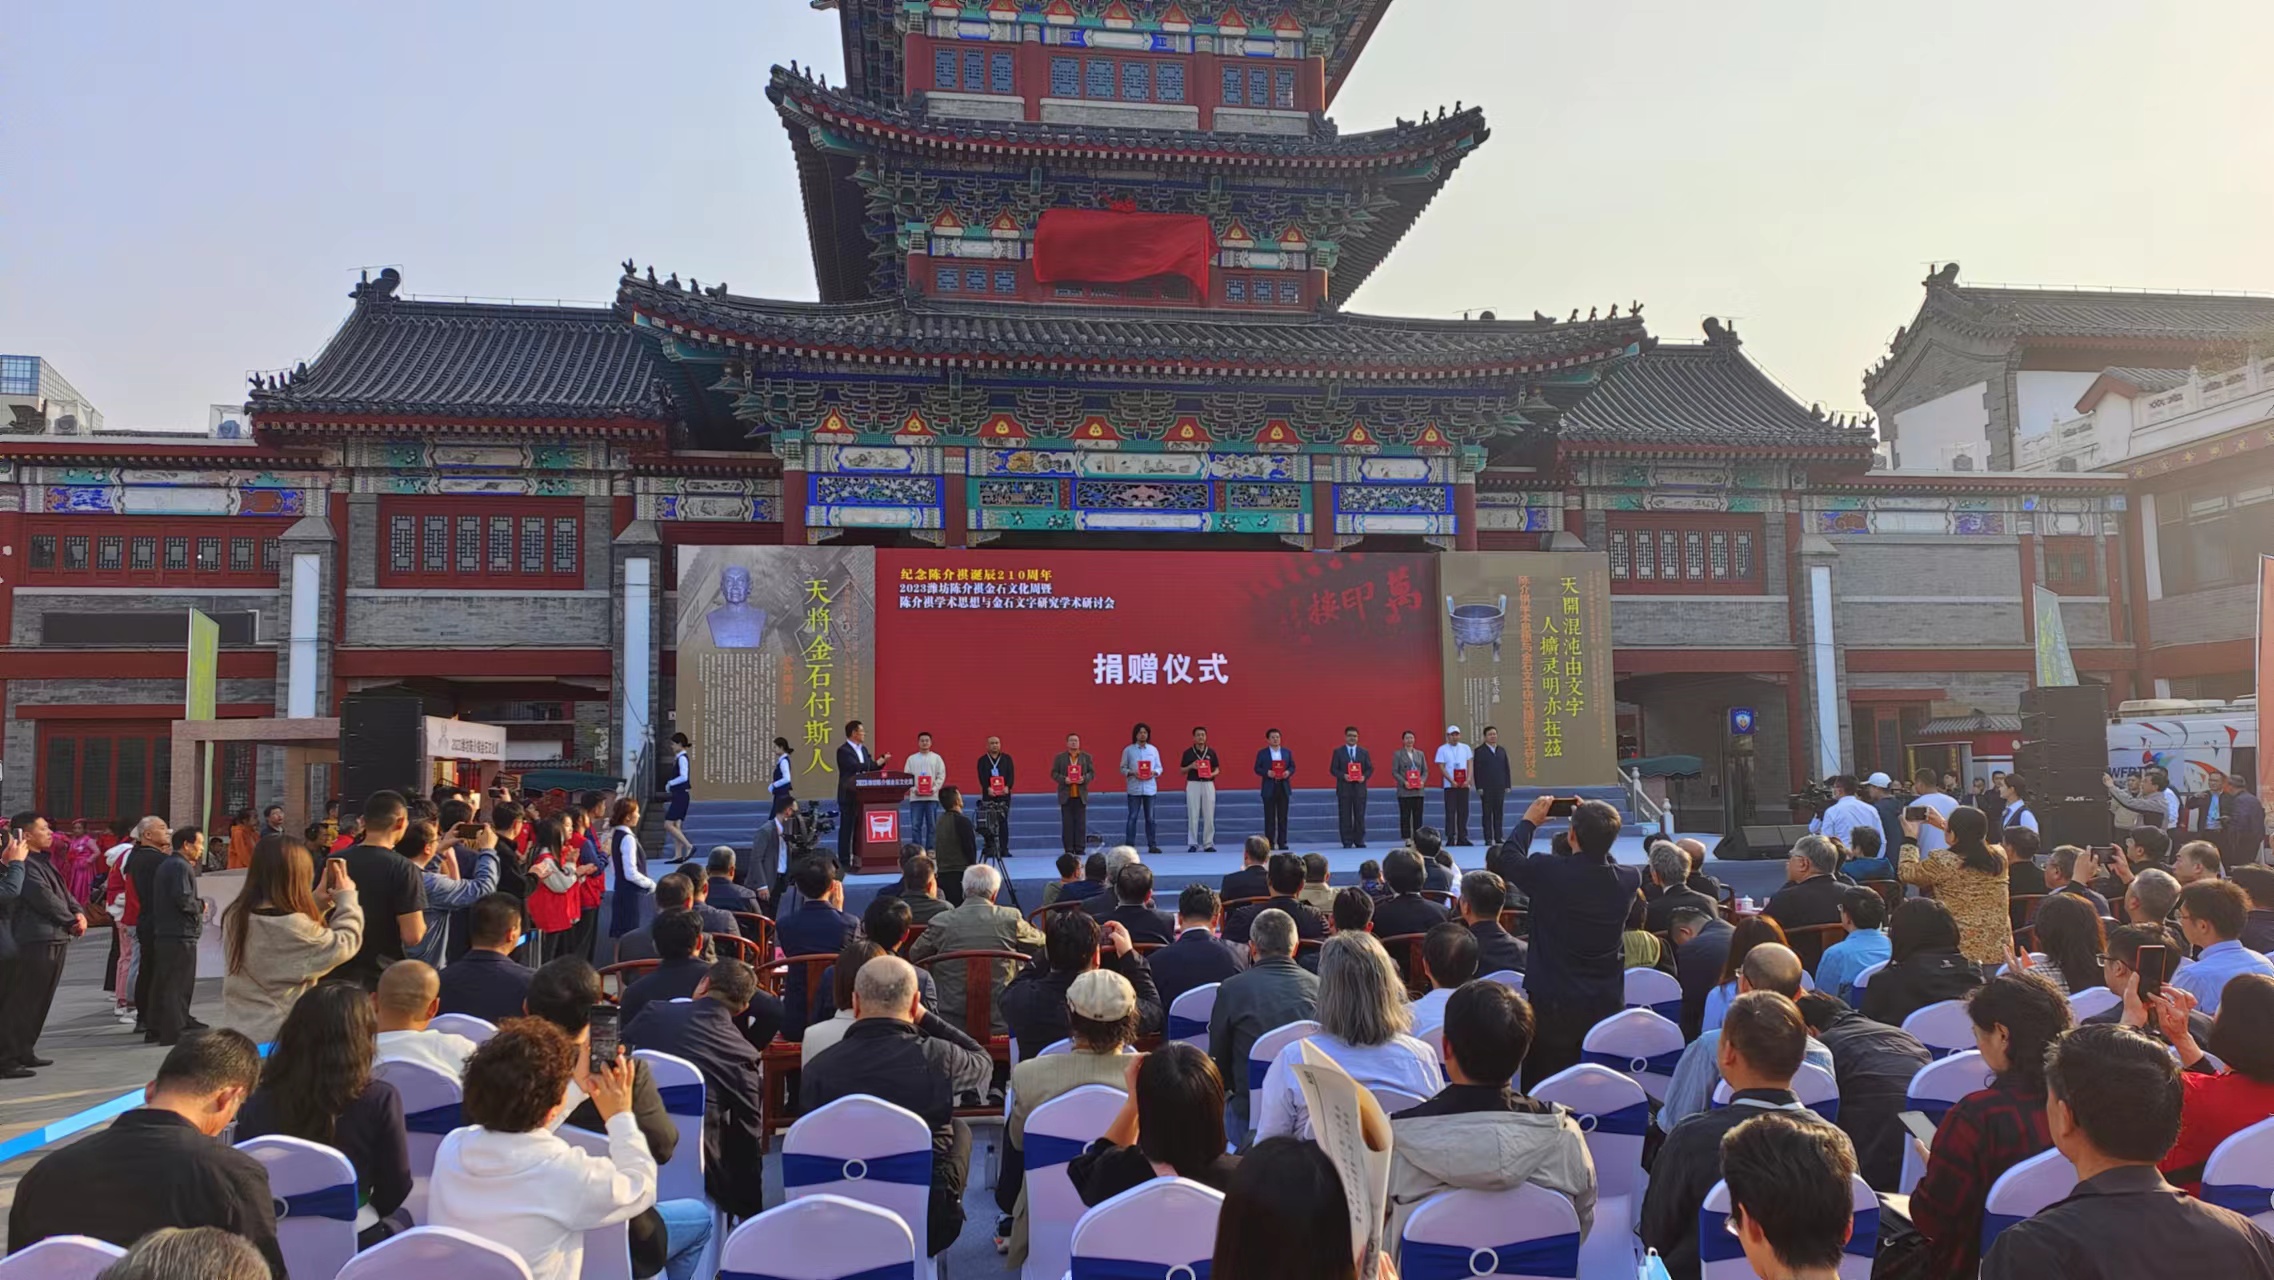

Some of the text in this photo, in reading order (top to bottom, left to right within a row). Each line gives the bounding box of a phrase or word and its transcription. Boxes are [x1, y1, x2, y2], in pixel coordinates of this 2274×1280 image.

[900, 568, 1052, 581] 纪念陈介祺诞辰210周年
[899, 583, 1052, 594] 2023潍坊陈介祺金石文化周暨
[899, 596, 1115, 609] 陈介祺学术思想与金石文字研究学术研讨会
[1093, 652, 1229, 685] 捐赠仪式
